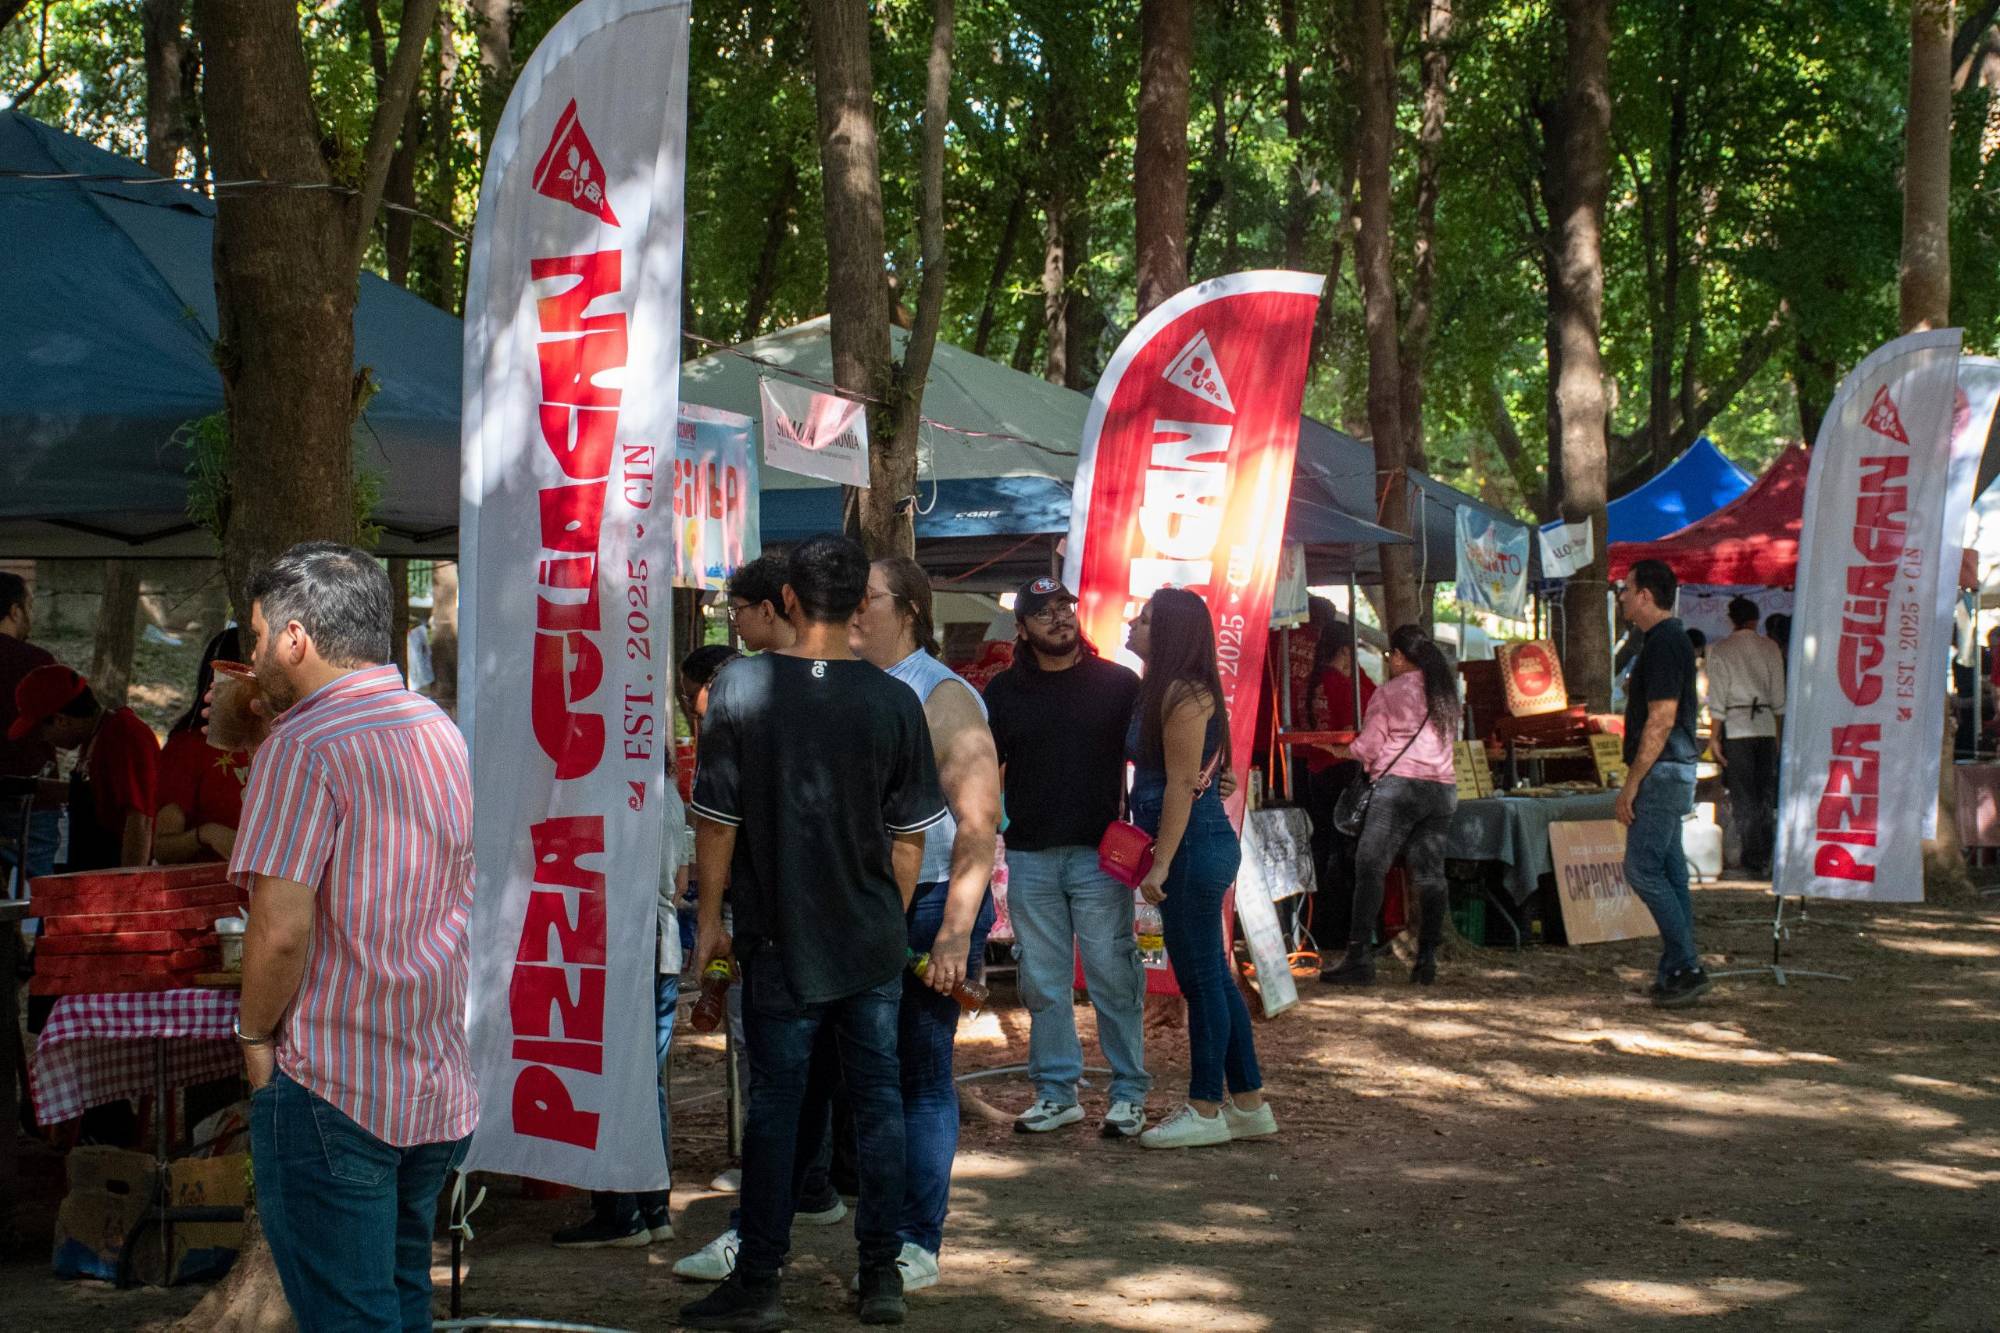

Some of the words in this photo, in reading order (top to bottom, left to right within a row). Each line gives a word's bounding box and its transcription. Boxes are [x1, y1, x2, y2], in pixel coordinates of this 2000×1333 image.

[955, 510, 1002, 519] CORE
[625, 559, 650, 660] 2025
[1216, 614, 1245, 677] 2025
[1900, 603, 1920, 652] 2025
[1896, 655, 1918, 700] EST.
[623, 672, 654, 761] EST.
[1814, 723, 1881, 883] PIZZA
[509, 815, 607, 1151] PIZZA
